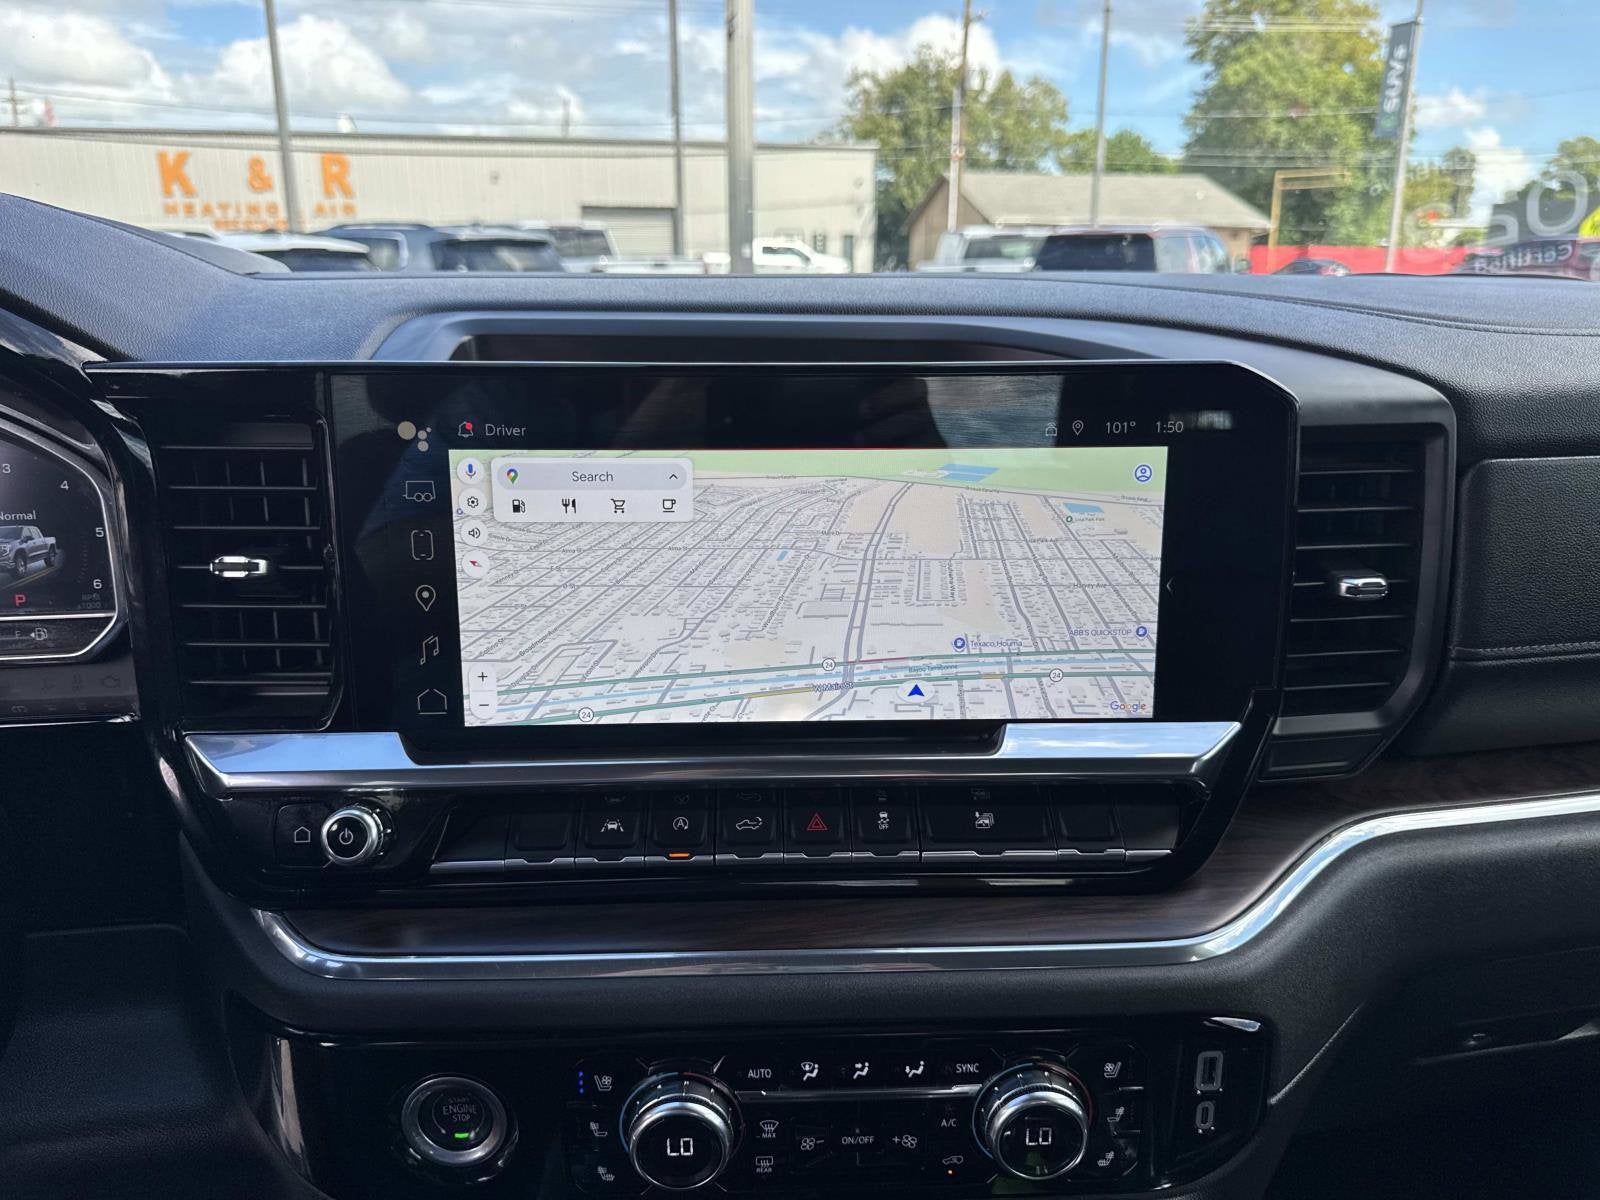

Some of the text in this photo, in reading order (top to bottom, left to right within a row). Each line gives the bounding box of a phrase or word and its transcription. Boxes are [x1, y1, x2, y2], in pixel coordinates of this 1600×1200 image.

[157, 150, 356, 198] K & R
[163, 201, 356, 217] HEATING AIR
[485, 423, 527, 437] Driver
[1105, 421, 1136, 434] 101°
[1155, 421, 1184, 434] 1:50
[2, 463, 11, 474] 3
[571, 470, 614, 483] Search
[60, 480, 70, 491] 4
[95, 527, 105, 538] 5
[93, 579, 103, 589] 6
[14, 594, 27, 607] P
[1110, 701, 1147, 713] Google
[581, 711, 591, 719] 24
[748, 1068, 772, 1079] AUTO
[956, 1062, 979, 1074] SYNC
[442, 1103, 477, 1115] ENGINE
[452, 1113, 471, 1121] STOP
[941, 1118, 957, 1129] A/C
[841, 1135, 875, 1145] ON/OFF
[1025, 1127, 1053, 1146] LO
[667, 1137, 694, 1156] LO
[756, 1166, 773, 1174] REAR
